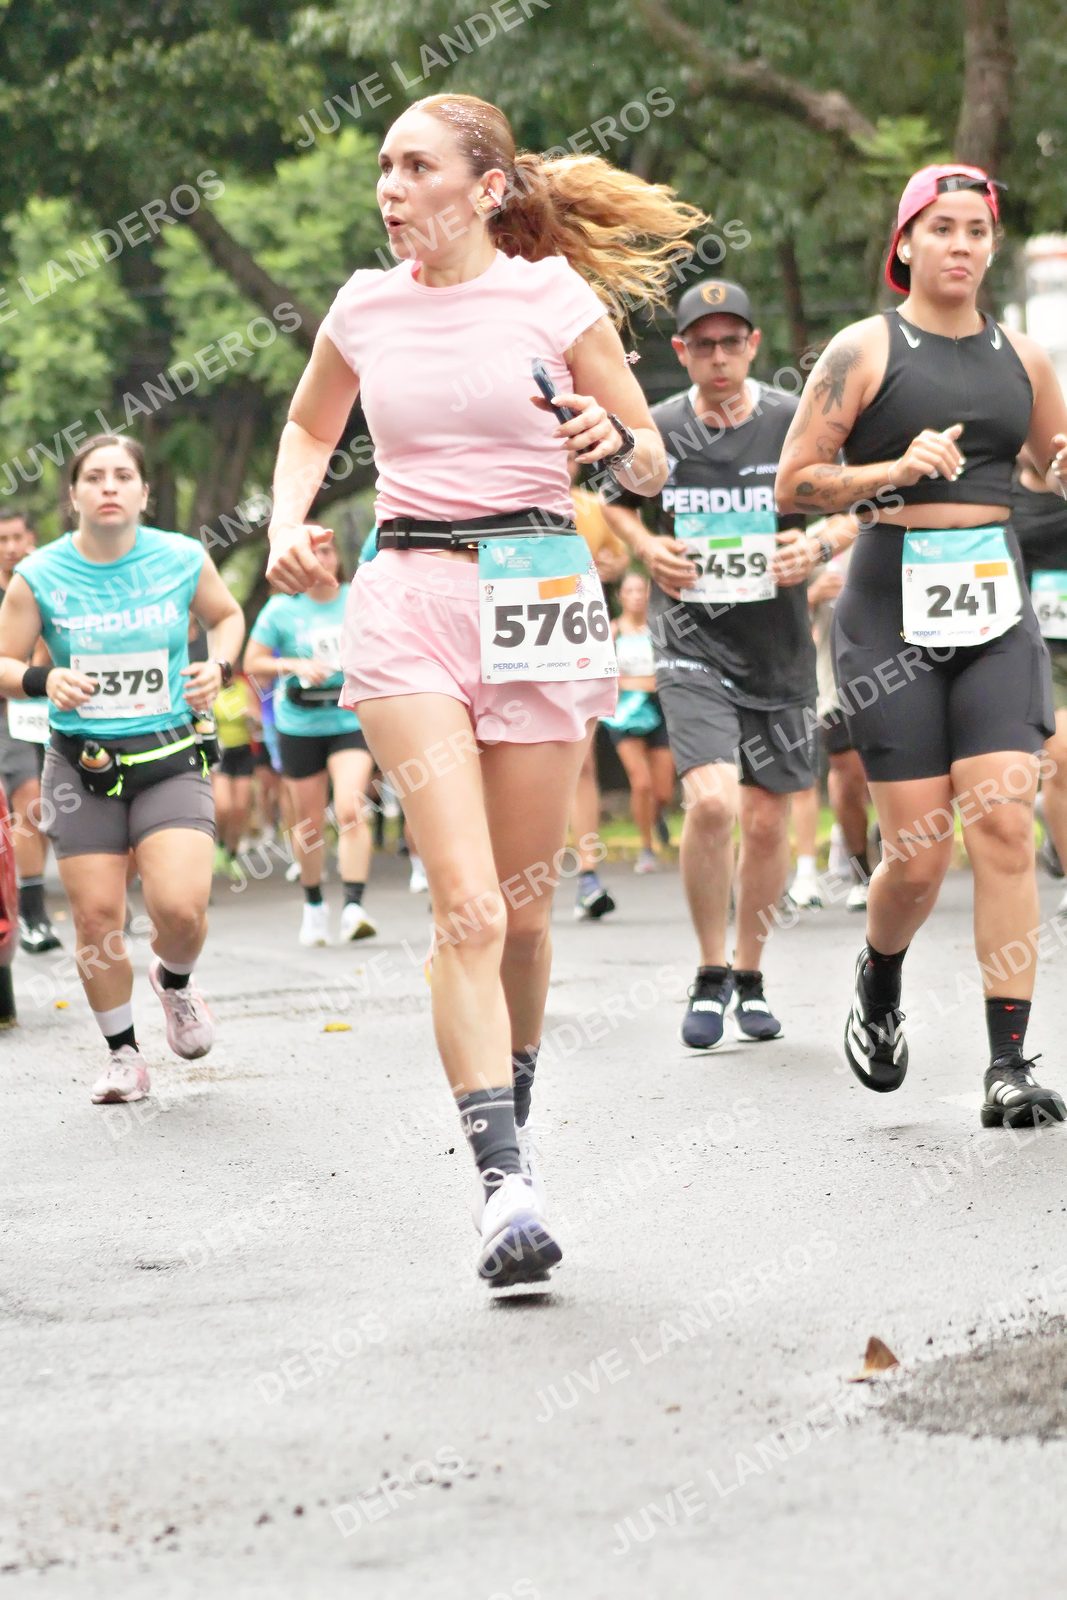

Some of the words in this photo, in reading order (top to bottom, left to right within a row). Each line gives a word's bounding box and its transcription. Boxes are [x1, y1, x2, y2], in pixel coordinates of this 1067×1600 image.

[662, 486, 778, 514] PERDUR
[925, 582, 997, 618] 241
[492, 600, 609, 648] 5766
